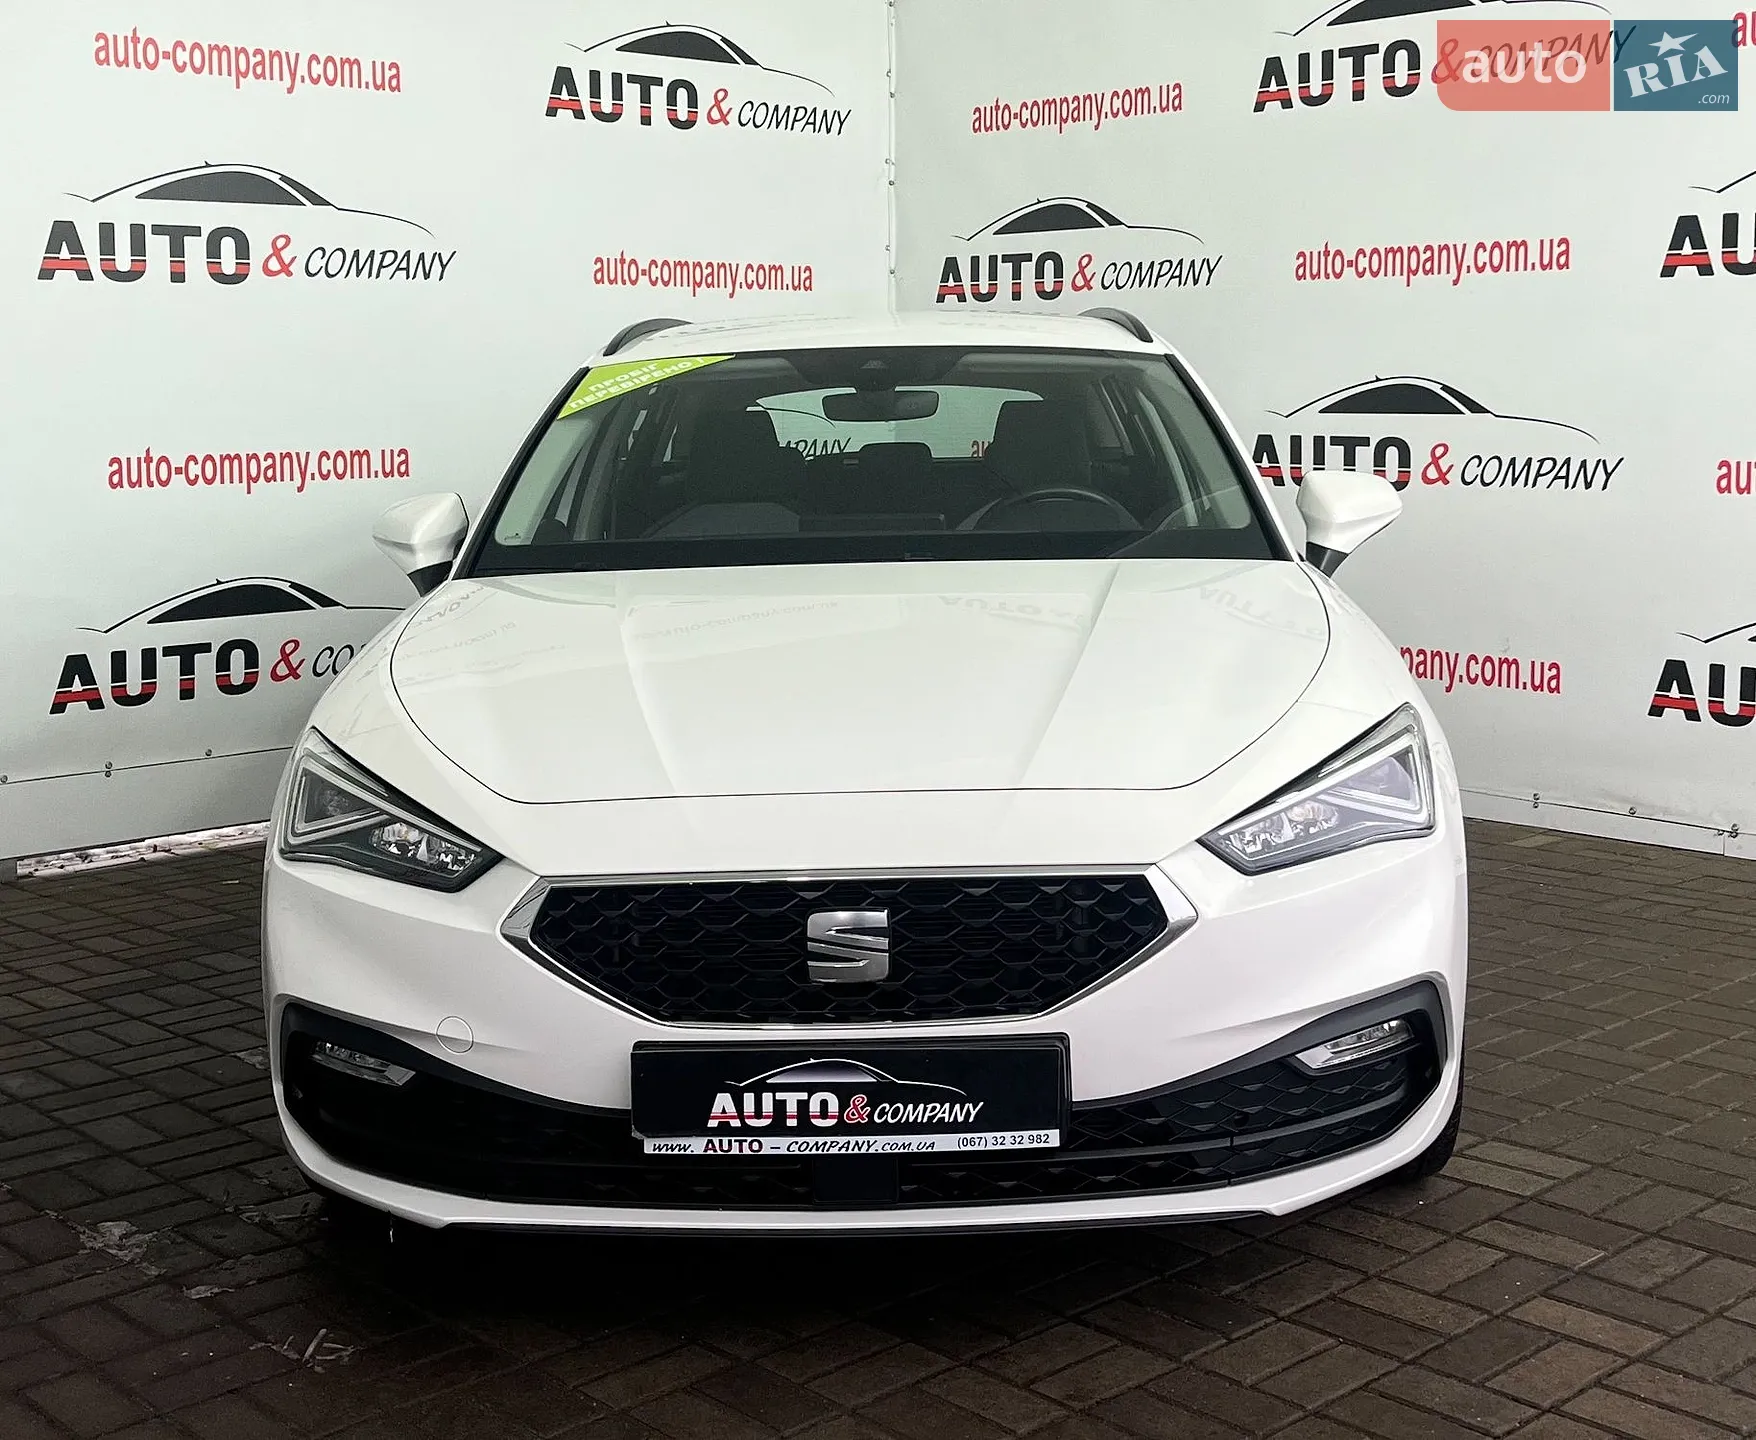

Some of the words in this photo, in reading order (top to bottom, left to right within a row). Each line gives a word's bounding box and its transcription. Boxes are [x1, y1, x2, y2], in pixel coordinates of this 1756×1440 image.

[94, 26, 401, 94] auto-company.com.ua
[1253, 39, 1420, 113] AUTO
[545, 66, 698, 130] AUTO
[706, 87, 733, 127] &
[737, 100, 852, 136] COMPANY
[972, 82, 1183, 135] auto-company.com.ua
[37, 220, 250, 285] AUTO
[261, 234, 297, 277] &
[304, 246, 457, 282] COMPANY
[593, 249, 813, 299] auto-company.com.ua
[936, 251, 1063, 303] AUTO
[1070, 253, 1096, 293] &
[1101, 255, 1223, 291] COMPANY
[1294, 236, 1571, 287] auto-company.com.ua
[108, 447, 411, 495] auto-company.com.ua
[1252, 434, 1412, 491] AUTO
[1421, 443, 1454, 485] &
[1461, 455, 1624, 491] COMPANY
[49, 638, 260, 715] AUTO
[270, 639, 305, 682] &
[707, 1092, 839, 1127] AUTO
[844, 1094, 872, 1123] &
[874, 1102, 983, 1123] COMPANY
[703, 1139, 763, 1154] AUTO
[957, 1136, 988, 1149] (067)
[991, 1135, 1006, 1146] 32
[1009, 1135, 1025, 1145] 32
[1027, 1133, 1050, 1145] 982
